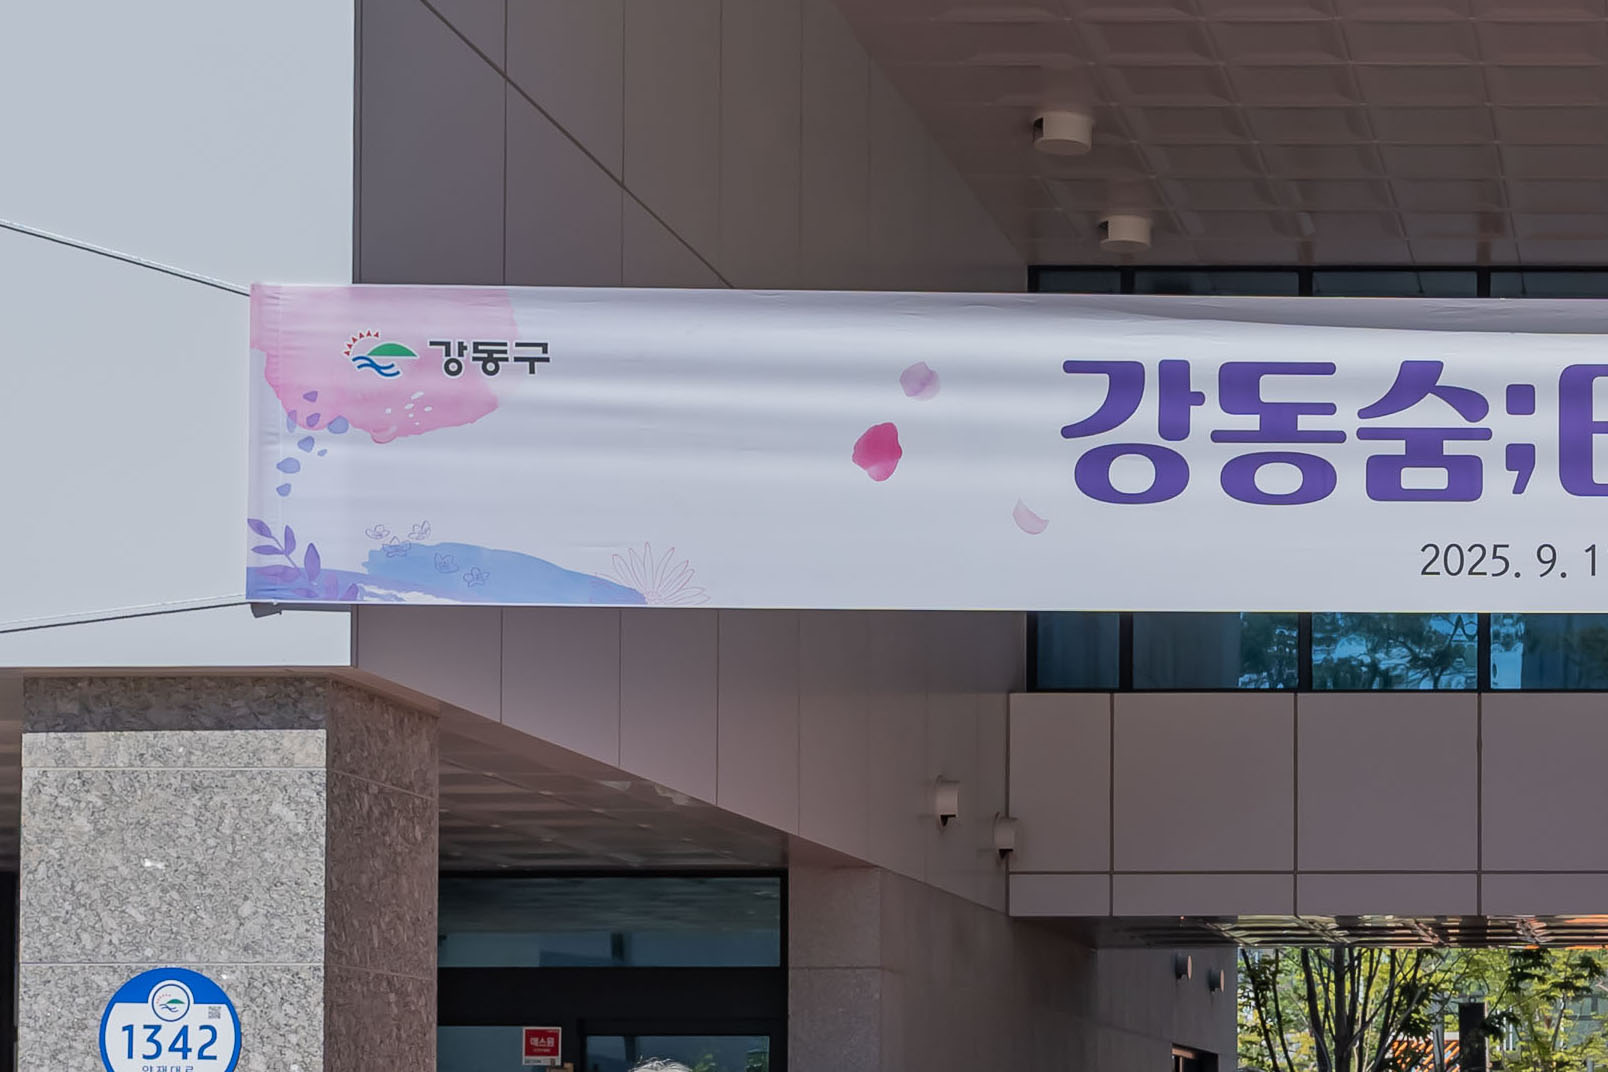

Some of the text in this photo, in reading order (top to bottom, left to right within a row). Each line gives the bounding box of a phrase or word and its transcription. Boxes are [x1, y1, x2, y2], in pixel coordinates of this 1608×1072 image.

[428, 339, 551, 377] 강동구
[1420, 543, 1522, 580] 2025.
[1536, 543, 1568, 580] 9.
[121, 1024, 218, 1060] 1342
